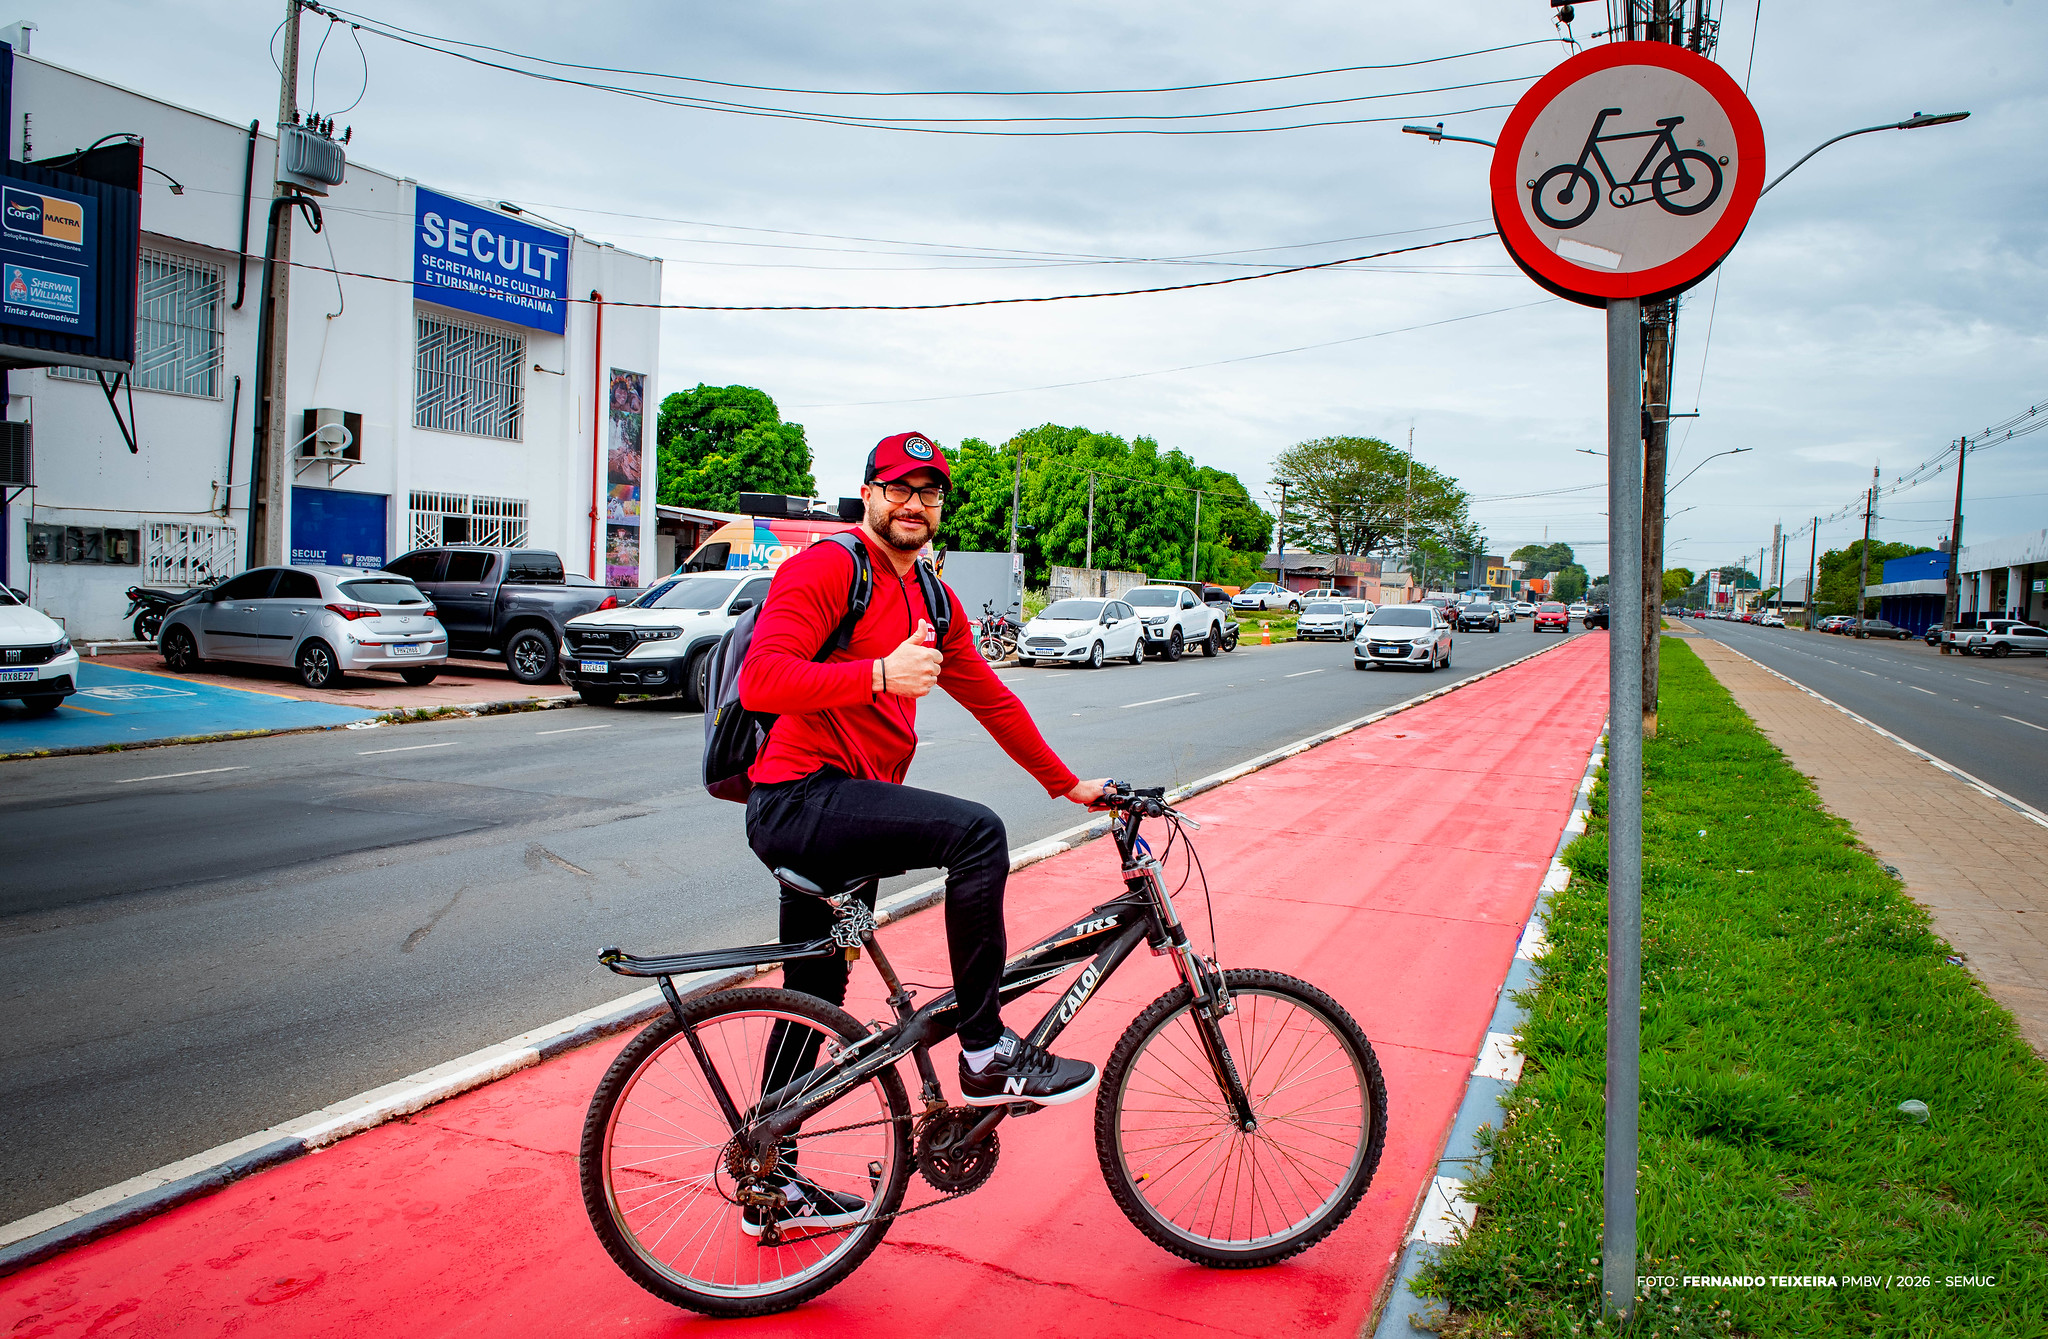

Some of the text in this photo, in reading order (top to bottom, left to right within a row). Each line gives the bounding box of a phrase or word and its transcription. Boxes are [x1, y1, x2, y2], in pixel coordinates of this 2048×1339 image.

[7, 206, 35, 221] Coral
[45, 213, 80, 227] MACTRA
[422, 211, 559, 282] SECULT
[31, 277, 73, 293] SHERWIN
[421, 253, 557, 301] SECRETARIA DE CULTURA
[425, 269, 554, 315] E TURISMO DE RORAIMA
[4, 305, 79, 324] Tintas Automotivas
[292, 549, 327, 559] SECULT
[355, 555, 381, 563] GOVERNO
[5, 649, 22, 662] FIAT
[1073, 914, 1119, 936] TRS
[1002, 1076, 1027, 1095] N
